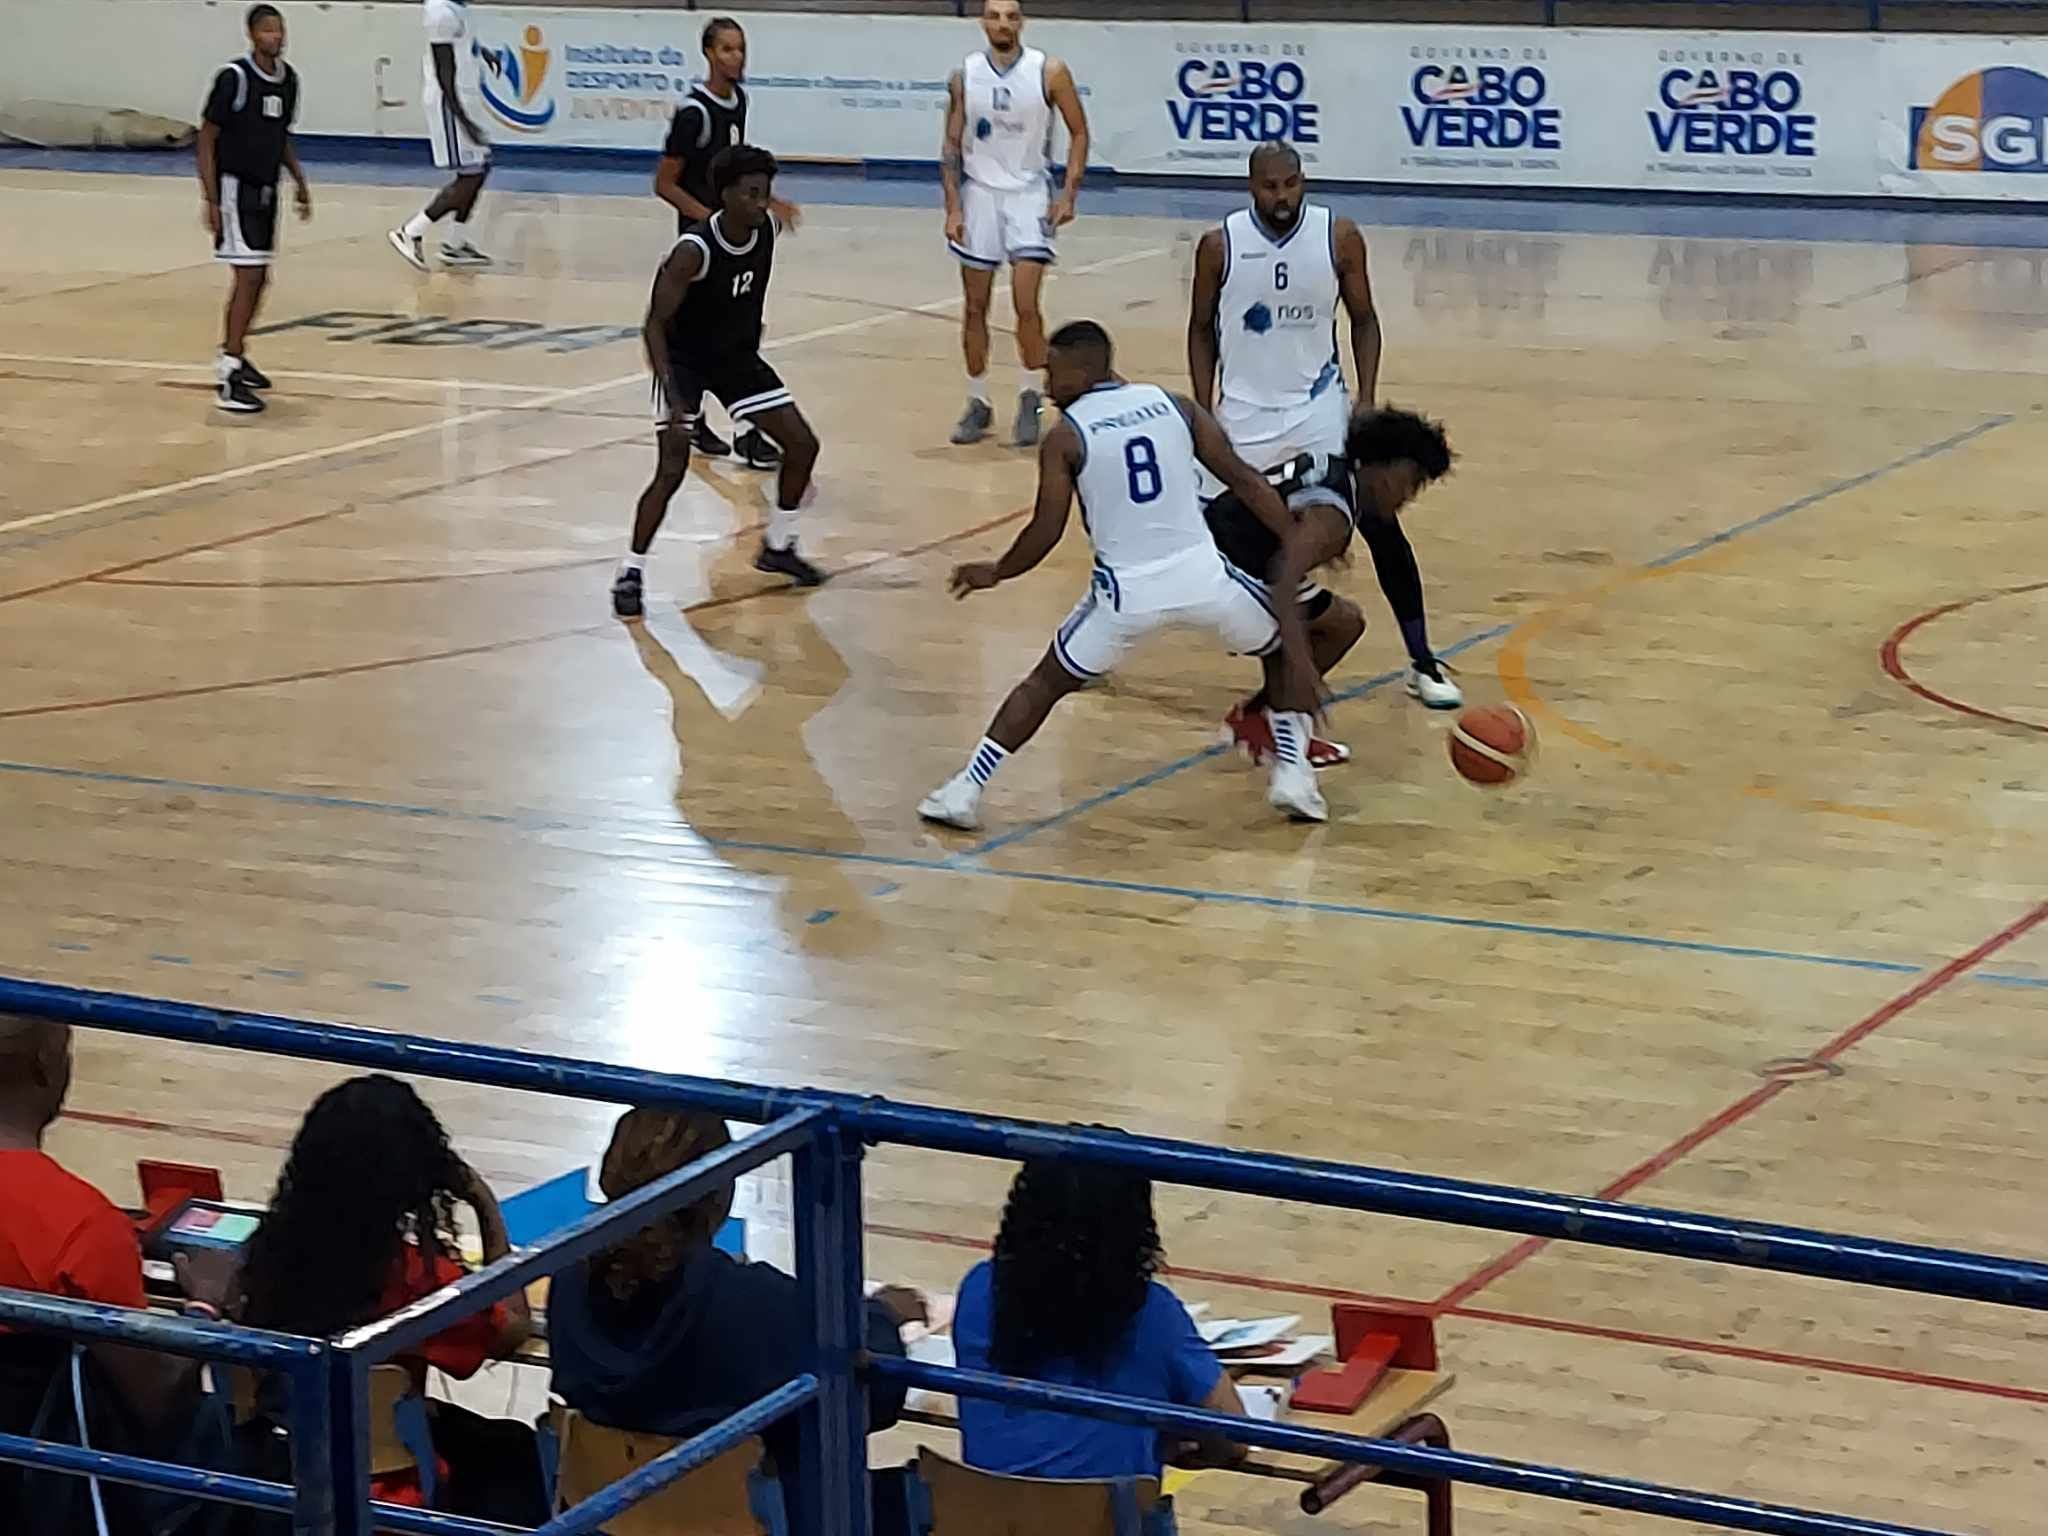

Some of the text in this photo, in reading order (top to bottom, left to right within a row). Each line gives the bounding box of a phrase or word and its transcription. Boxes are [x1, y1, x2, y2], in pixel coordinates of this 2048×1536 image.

[566, 71, 669, 90] DESPORTO
[1178, 60, 1304, 101] CABO
[1413, 65, 1545, 106] CABO
[1660, 69, 1801, 112] CABO
[1166, 99, 1319, 143] VERDE
[1400, 106, 1562, 149] VERDE
[1646, 111, 1816, 156] VERDE
[1931, 115, 2048, 165] SG
[732, 271, 754, 297] 12
[1275, 261, 1289, 290] 6
[1278, 304, 1314, 320] nos
[1125, 436, 1162, 503] 8
